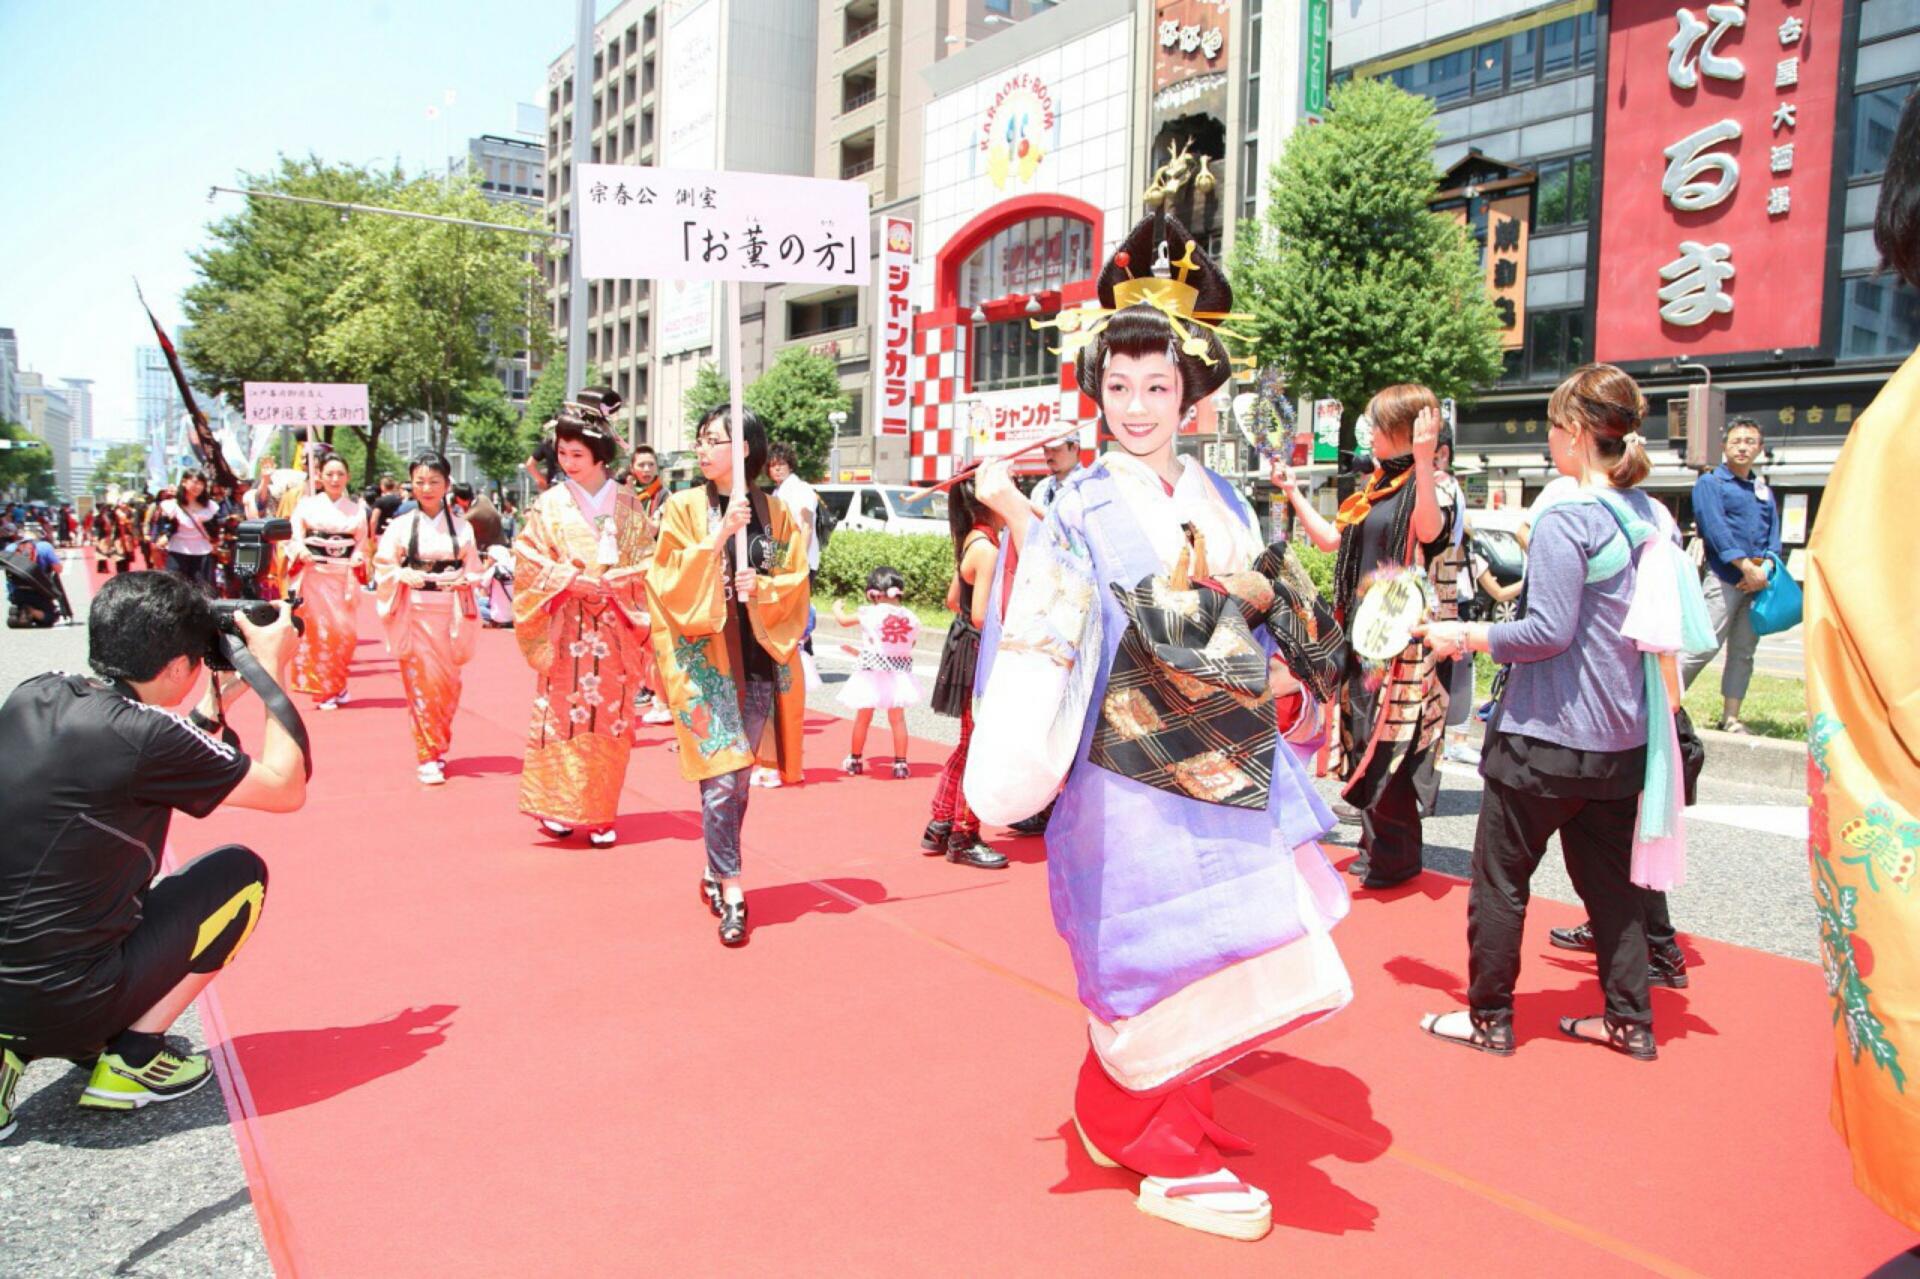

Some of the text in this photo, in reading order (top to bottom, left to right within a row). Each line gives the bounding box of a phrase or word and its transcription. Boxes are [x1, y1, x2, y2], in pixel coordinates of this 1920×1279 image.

[588, 181, 717, 209] 宗春公 側室
[885, 264, 910, 408] ジャンカラ
[1504, 417, 1551, 434] 名古
[881, 614, 913, 644] 祭
